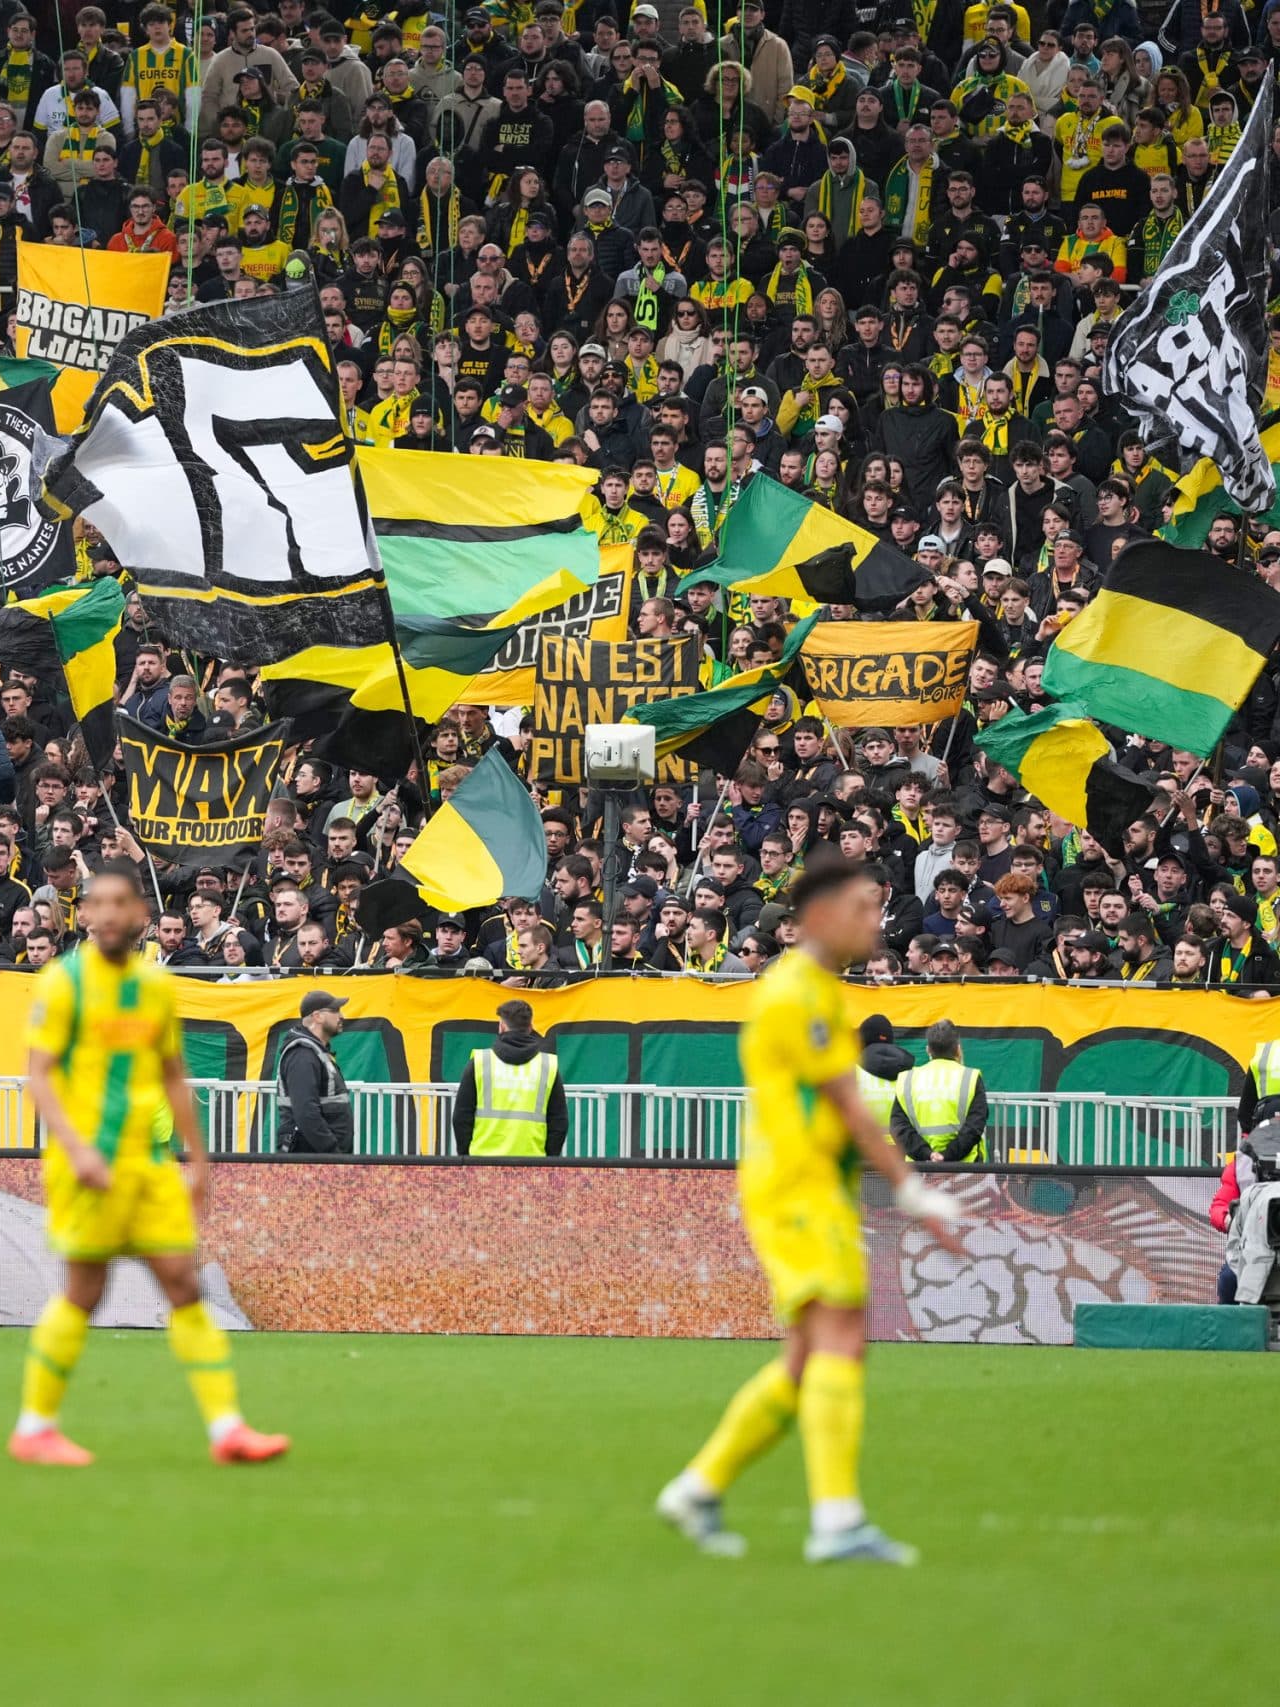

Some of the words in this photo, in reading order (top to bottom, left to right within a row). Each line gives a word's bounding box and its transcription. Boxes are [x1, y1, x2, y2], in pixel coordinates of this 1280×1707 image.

[139, 69, 180, 80] EUREST
[5, 412, 35, 440] THESE
[17, 522, 55, 572] NANTES
[542, 634, 592, 682] ON
[610, 637, 687, 682] EST
[801, 650, 968, 698] BRIGADE
[536, 685, 696, 734] NANT
[121, 737, 283, 819] MAX
